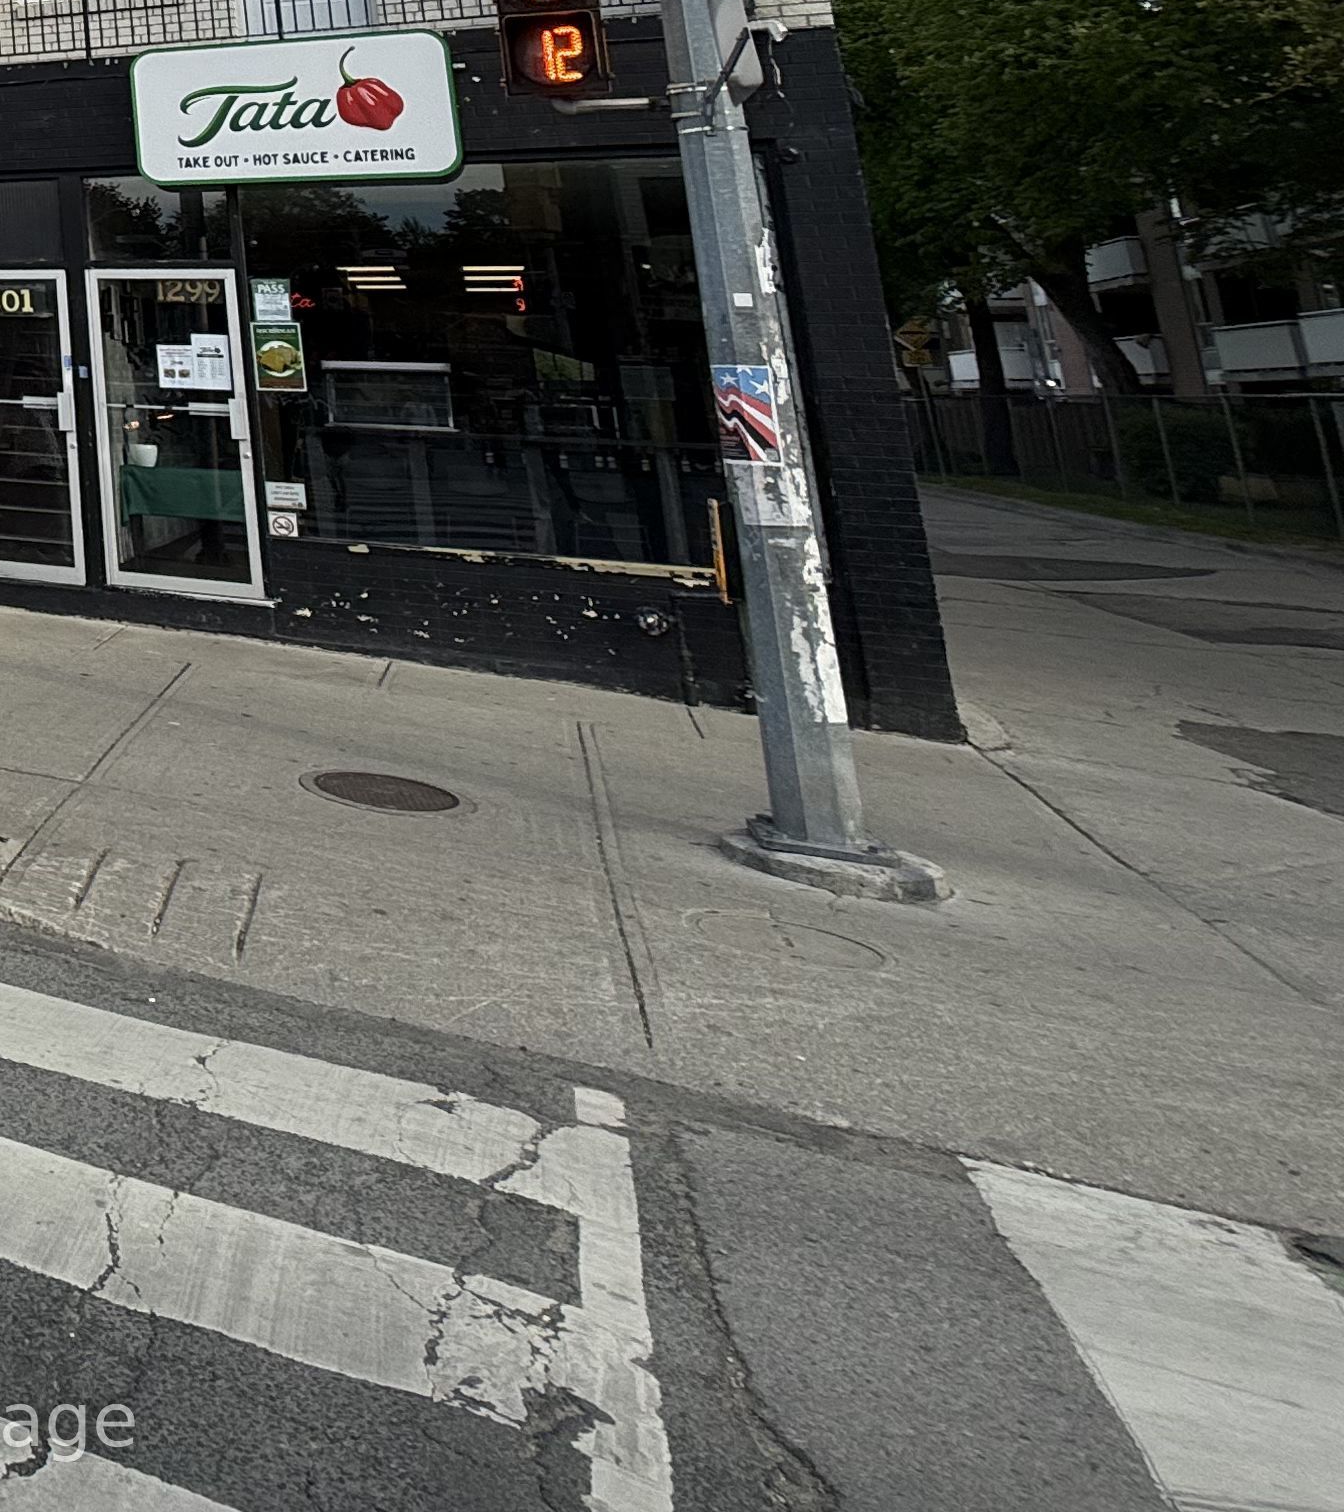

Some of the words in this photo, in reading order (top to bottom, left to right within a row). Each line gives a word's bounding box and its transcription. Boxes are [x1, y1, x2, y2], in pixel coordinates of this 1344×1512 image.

[542, 25, 583, 82] 12
[177, 75, 337, 148] Tata
[177, 156, 210, 169] TAKE
[214, 154, 239, 167] OUT
[253, 153, 279, 166] HOT
[282, 151, 329, 165] SAUCE
[343, 148, 415, 163] CATERING
[157, 279, 220, 303] 1299
[257, 284, 285, 294] PASS
